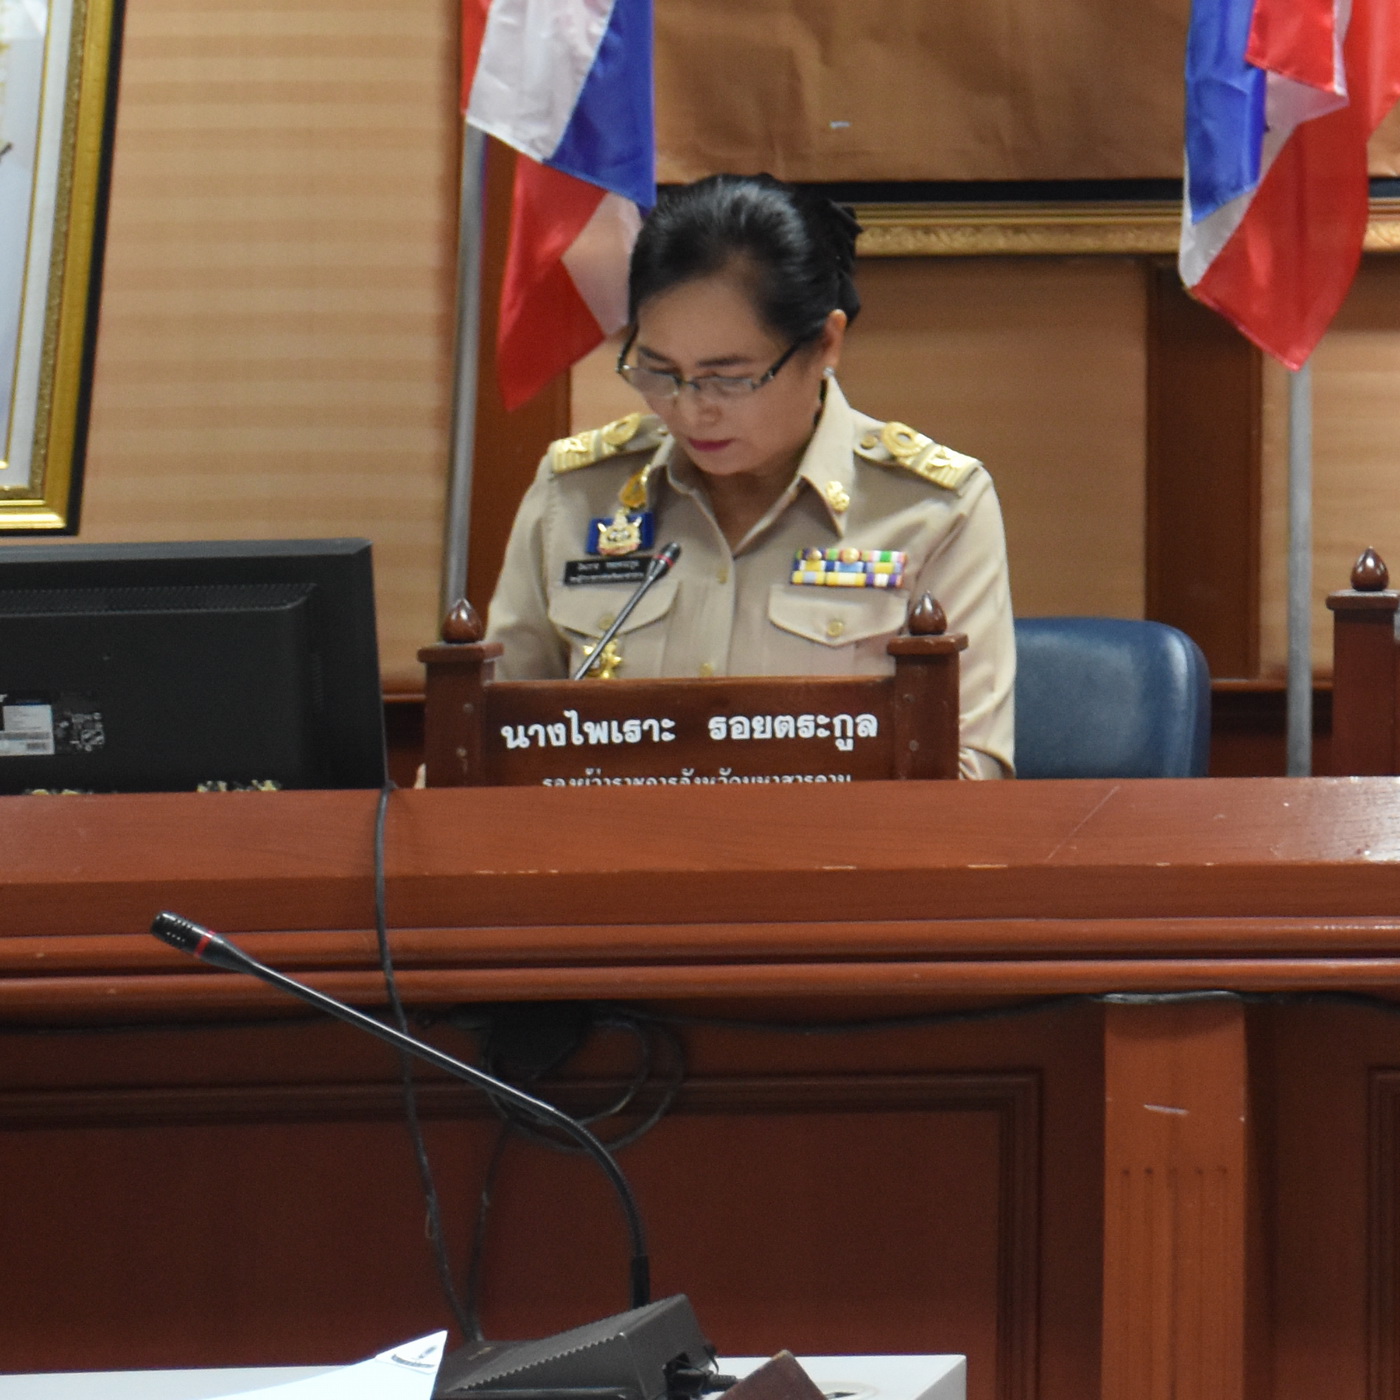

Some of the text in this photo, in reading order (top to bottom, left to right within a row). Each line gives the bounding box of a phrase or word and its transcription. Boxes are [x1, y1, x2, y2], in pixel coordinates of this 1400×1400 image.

[502, 709, 878, 752] นางไพเราะ รอยตระกูล
